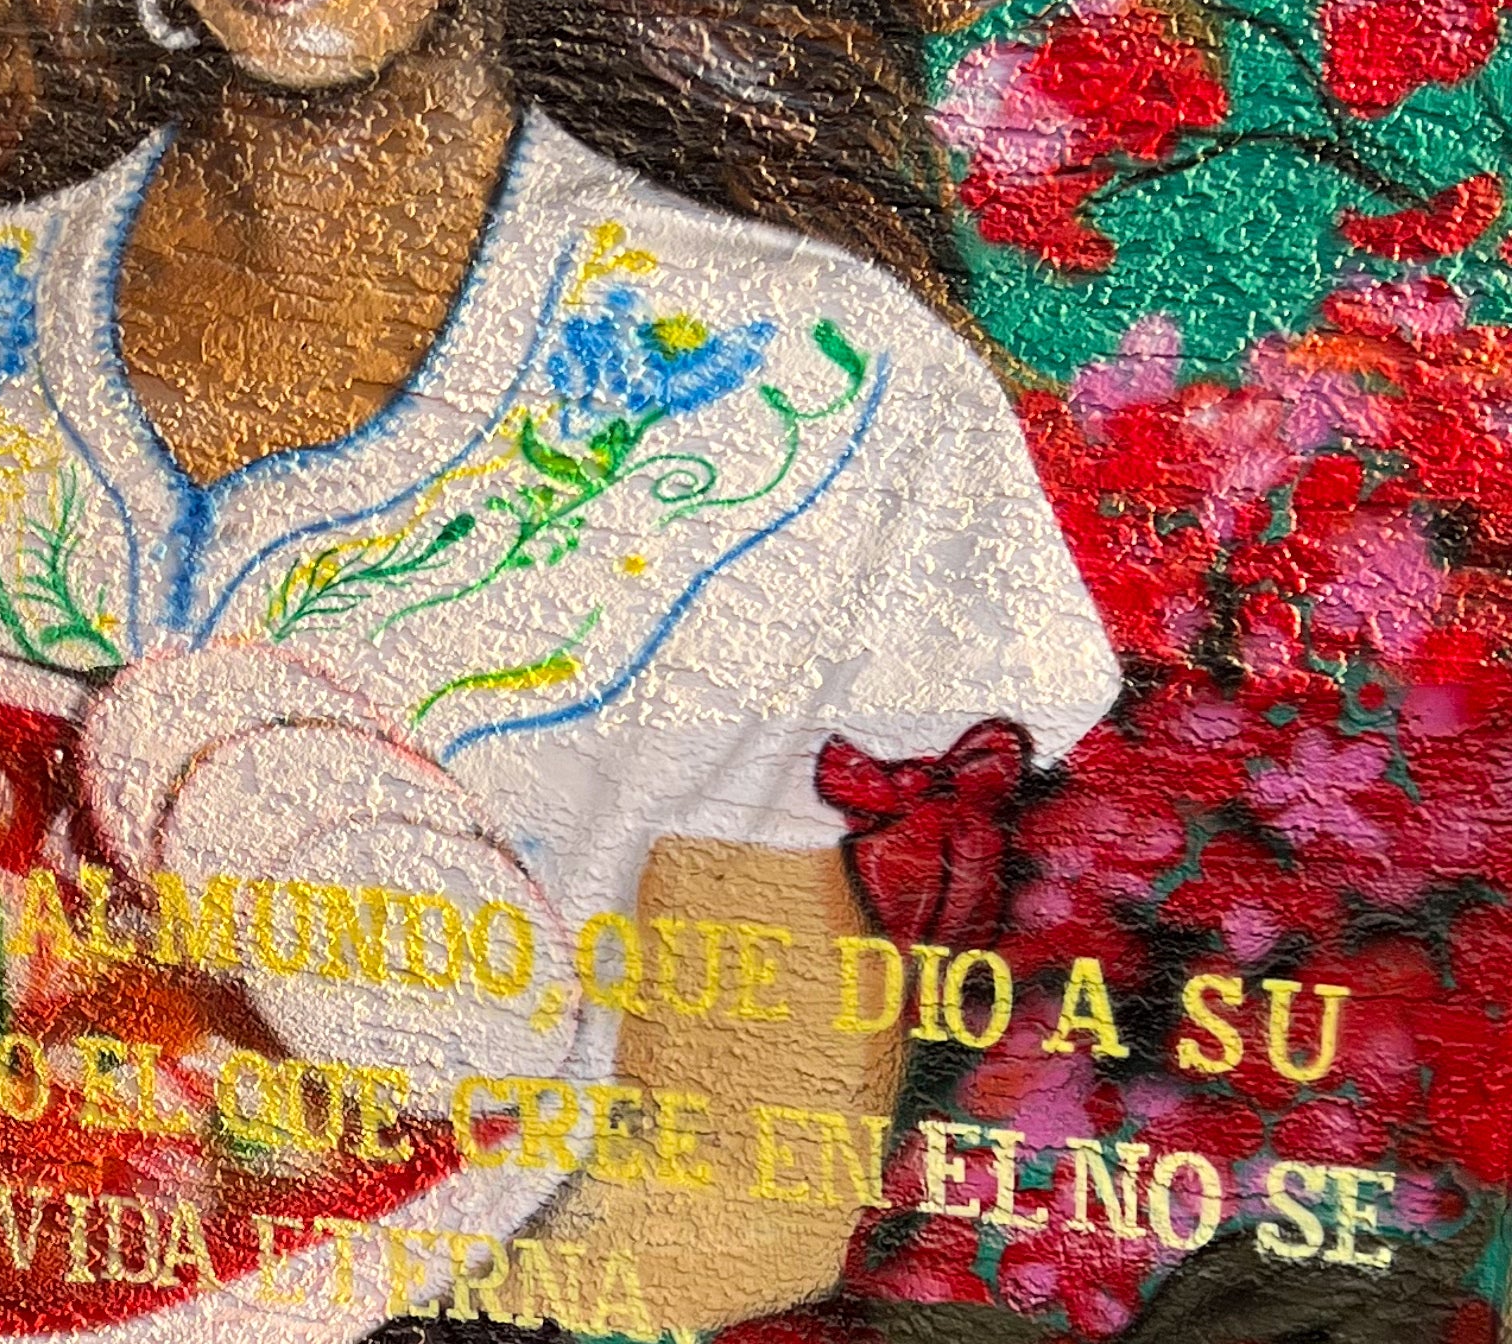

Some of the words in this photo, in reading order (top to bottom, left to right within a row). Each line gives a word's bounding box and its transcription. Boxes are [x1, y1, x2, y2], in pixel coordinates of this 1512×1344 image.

[575, 911, 792, 1023] QUE
[830, 935, 1012, 1050] DIO
[1040, 957, 1131, 1059] A
[1176, 973, 1351, 1083] SU
[450, 1073, 714, 1189] CREE
[750, 1106, 893, 1211] EN
[917, 1120, 1049, 1232] EL
[1064, 1136, 1224, 1253] NO
[1254, 1159, 1397, 1270] SE
